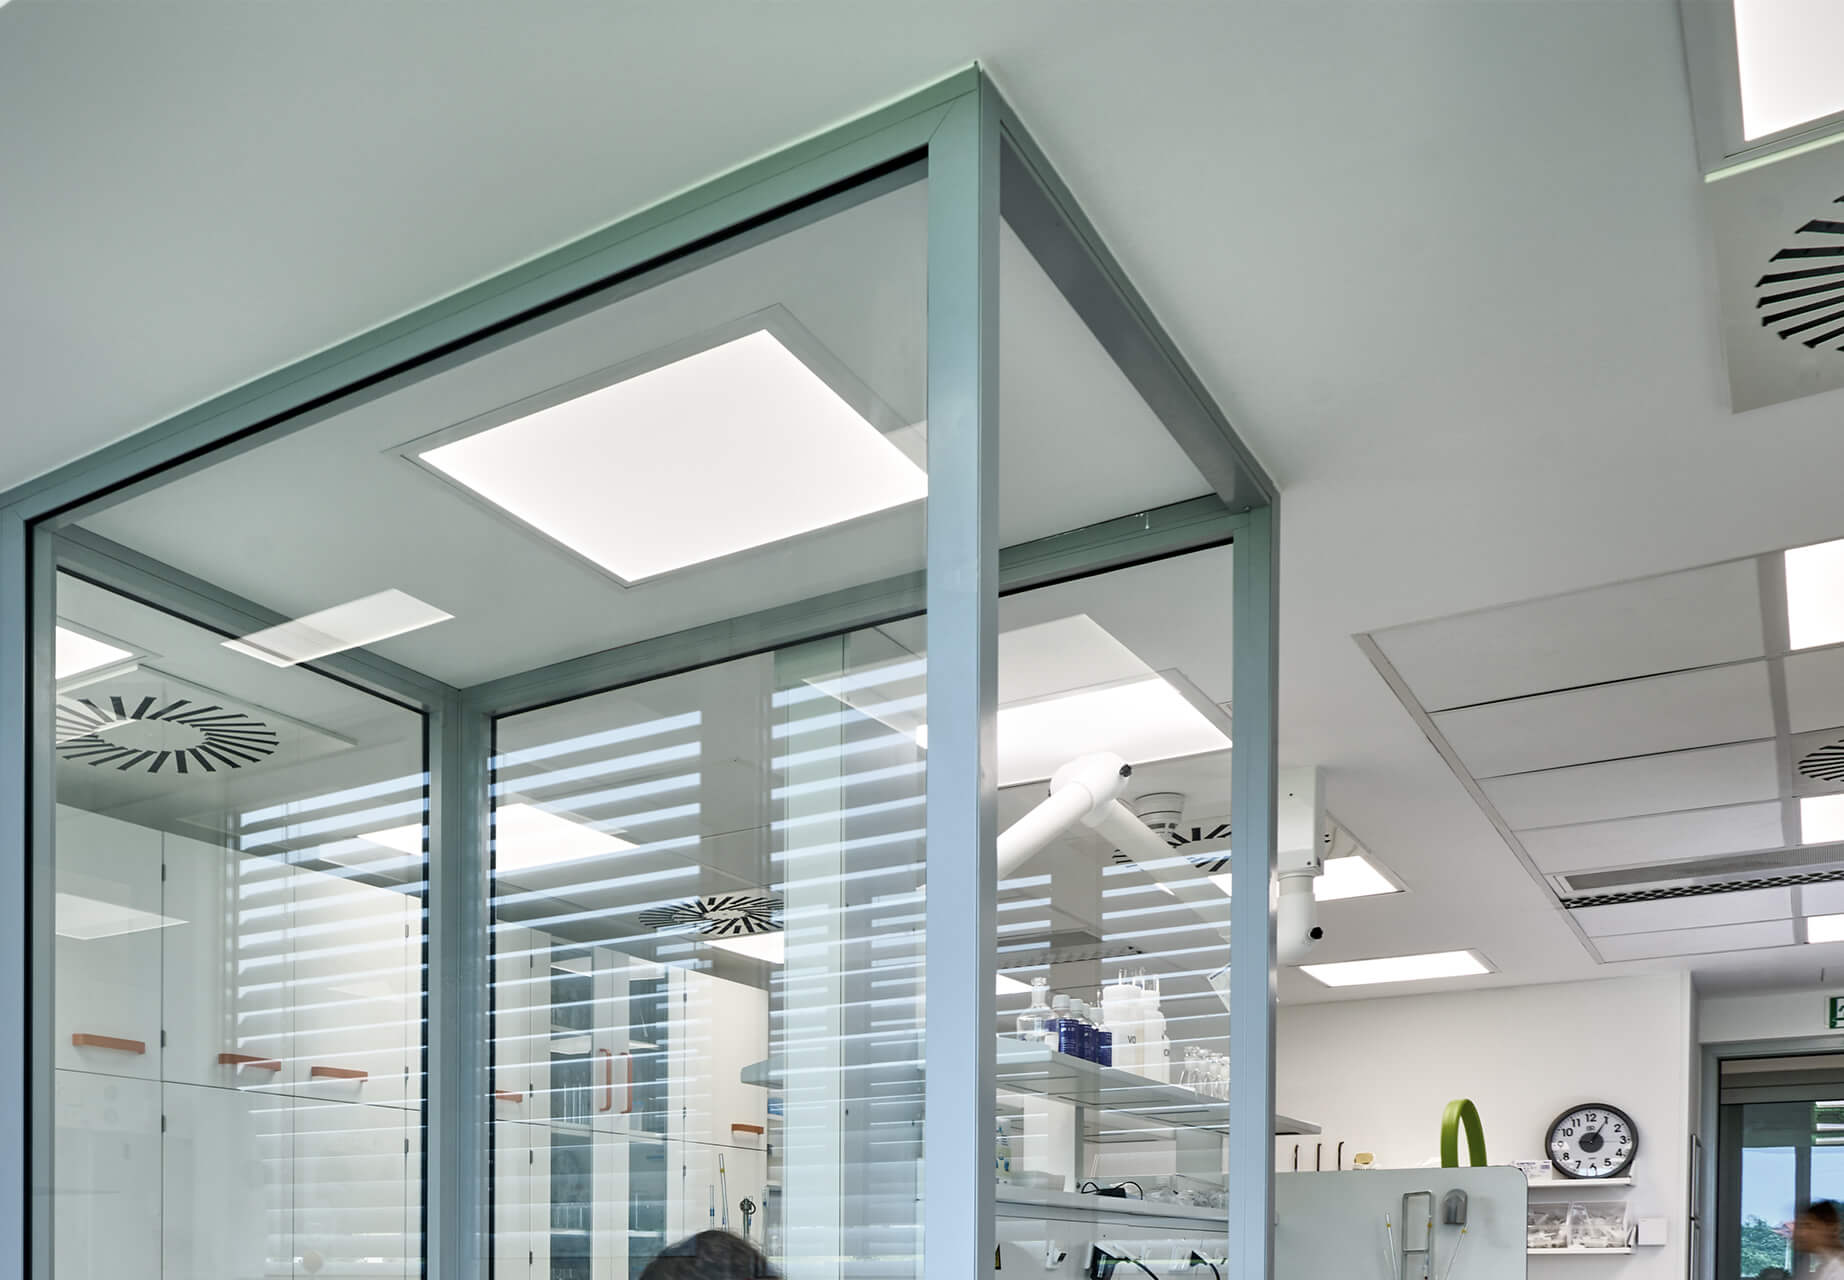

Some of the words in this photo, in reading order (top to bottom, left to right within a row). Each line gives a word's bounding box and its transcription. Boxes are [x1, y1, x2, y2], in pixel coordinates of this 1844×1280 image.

[1585, 1113, 1597, 1122] 12
[1604, 1116, 1609, 1124] 1
[1571, 1118, 1581, 1127] 11
[1561, 1128, 1574, 1137] 10
[1614, 1124, 1622, 1133] 2
[1620, 1135, 1627, 1144] 3
[1562, 1152, 1570, 1161] 8
[1615, 1148, 1623, 1156] 4
[1575, 1160, 1582, 1169] 7
[1604, 1158, 1612, 1166] 5
